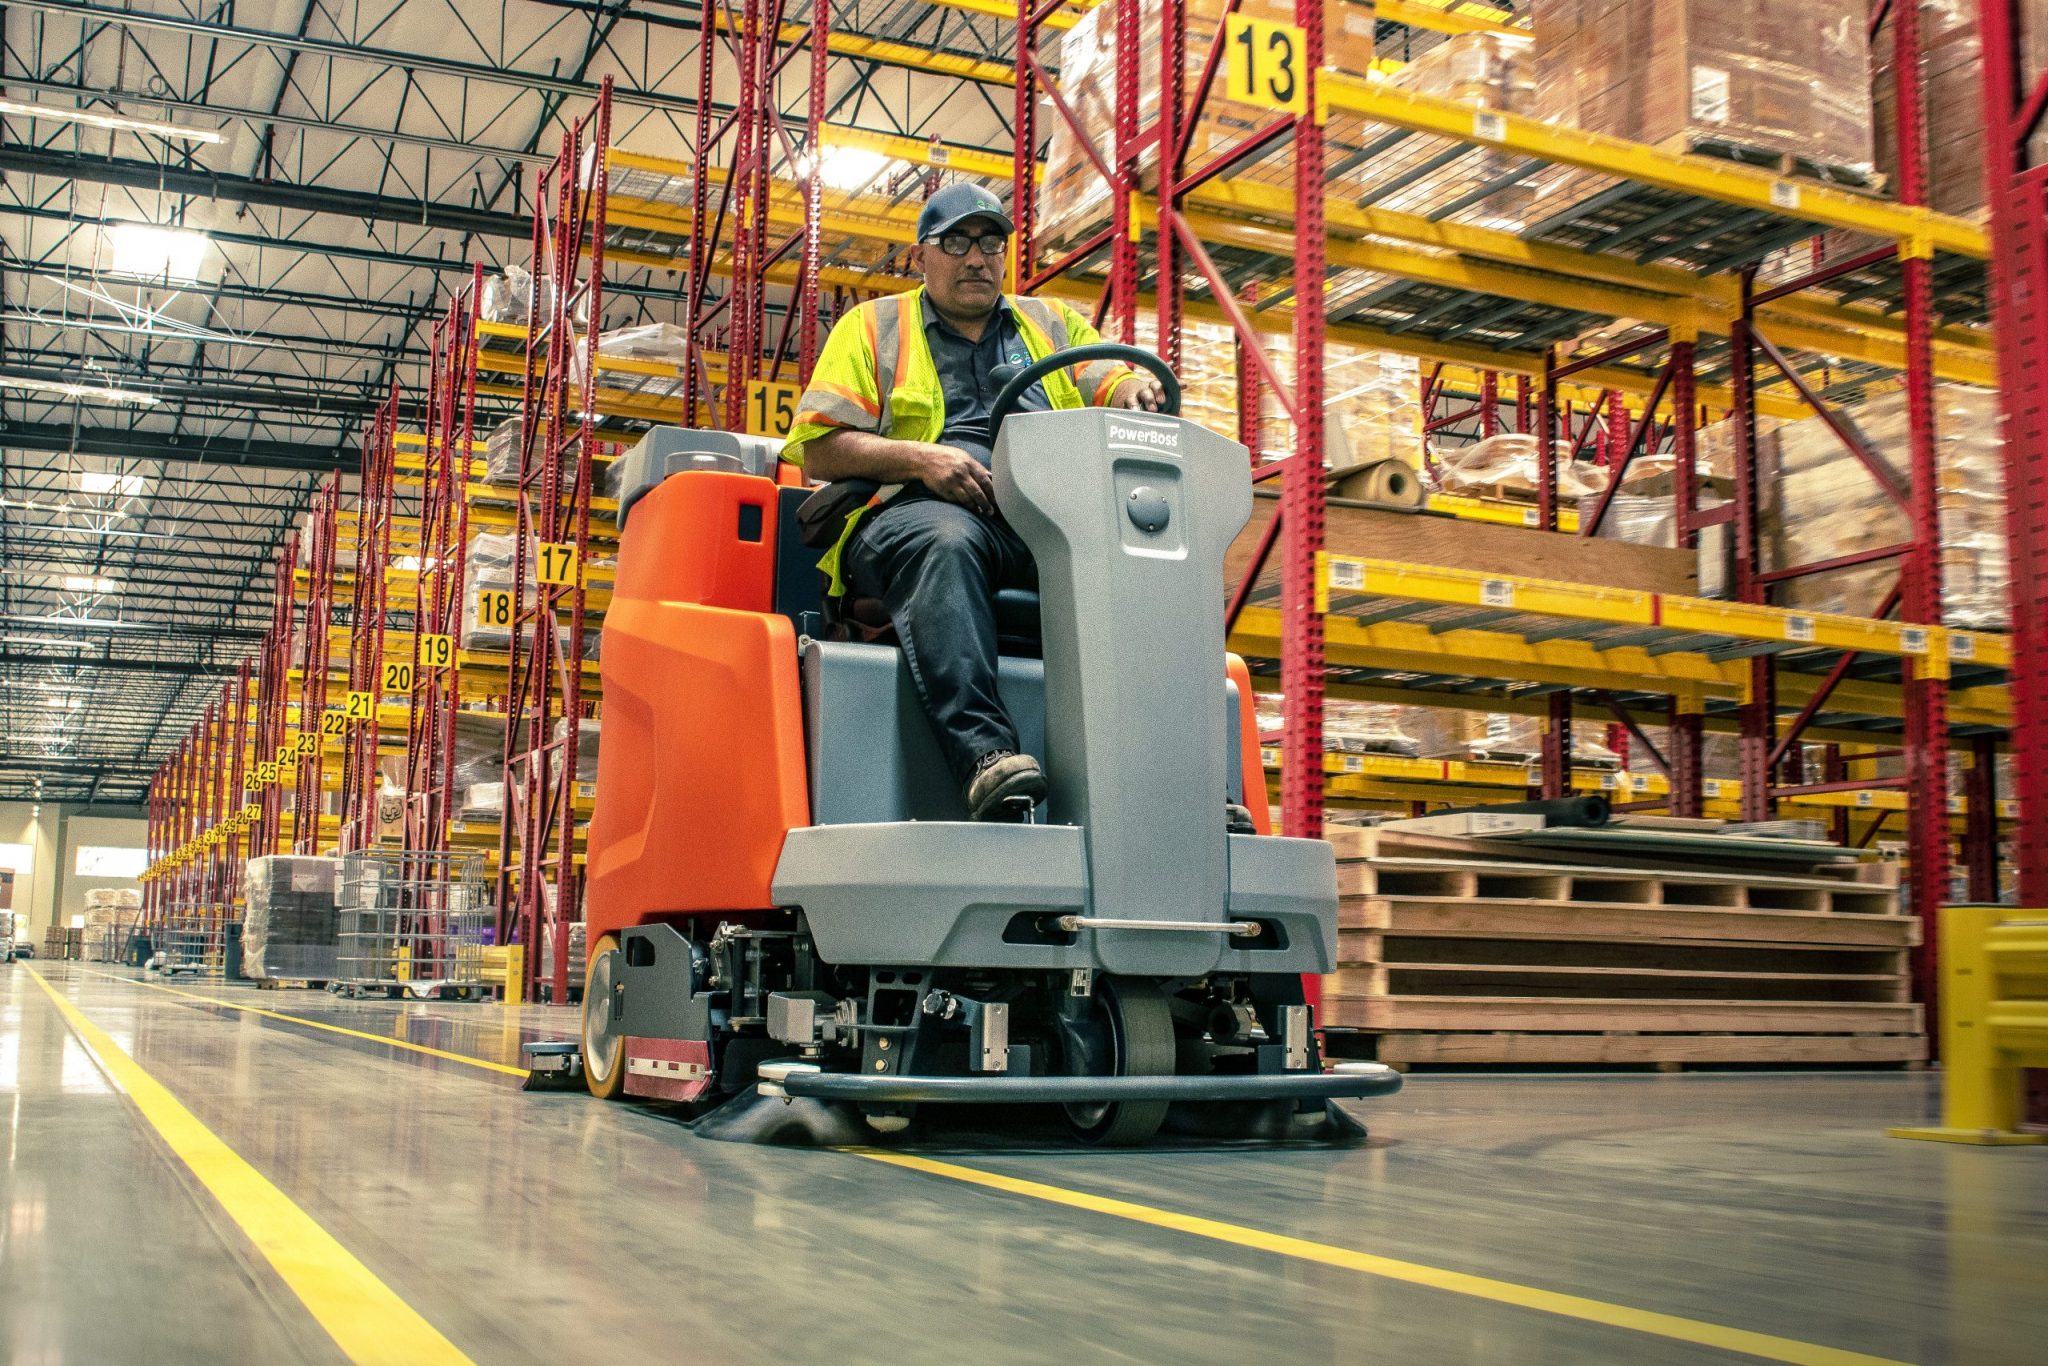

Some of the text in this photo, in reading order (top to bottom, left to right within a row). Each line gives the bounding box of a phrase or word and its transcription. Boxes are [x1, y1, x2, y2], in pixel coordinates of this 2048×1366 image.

[1237, 24, 1295, 103] 13
[754, 386, 794, 435] 15
[1109, 425, 1178, 447] PowerBoss
[542, 546, 573, 581] 17
[482, 592, 509, 625] 18
[425, 636, 449, 664] 19
[386, 664, 410, 691] 20
[349, 694, 370, 717] 21
[324, 714, 345, 735] 22
[297, 734, 316, 753] 23
[278, 748, 296, 766] 24
[245, 774, 261, 790] 26
[260, 763, 277, 780] 25
[246, 805, 260, 819] 27
[223, 819, 236, 832] 29
